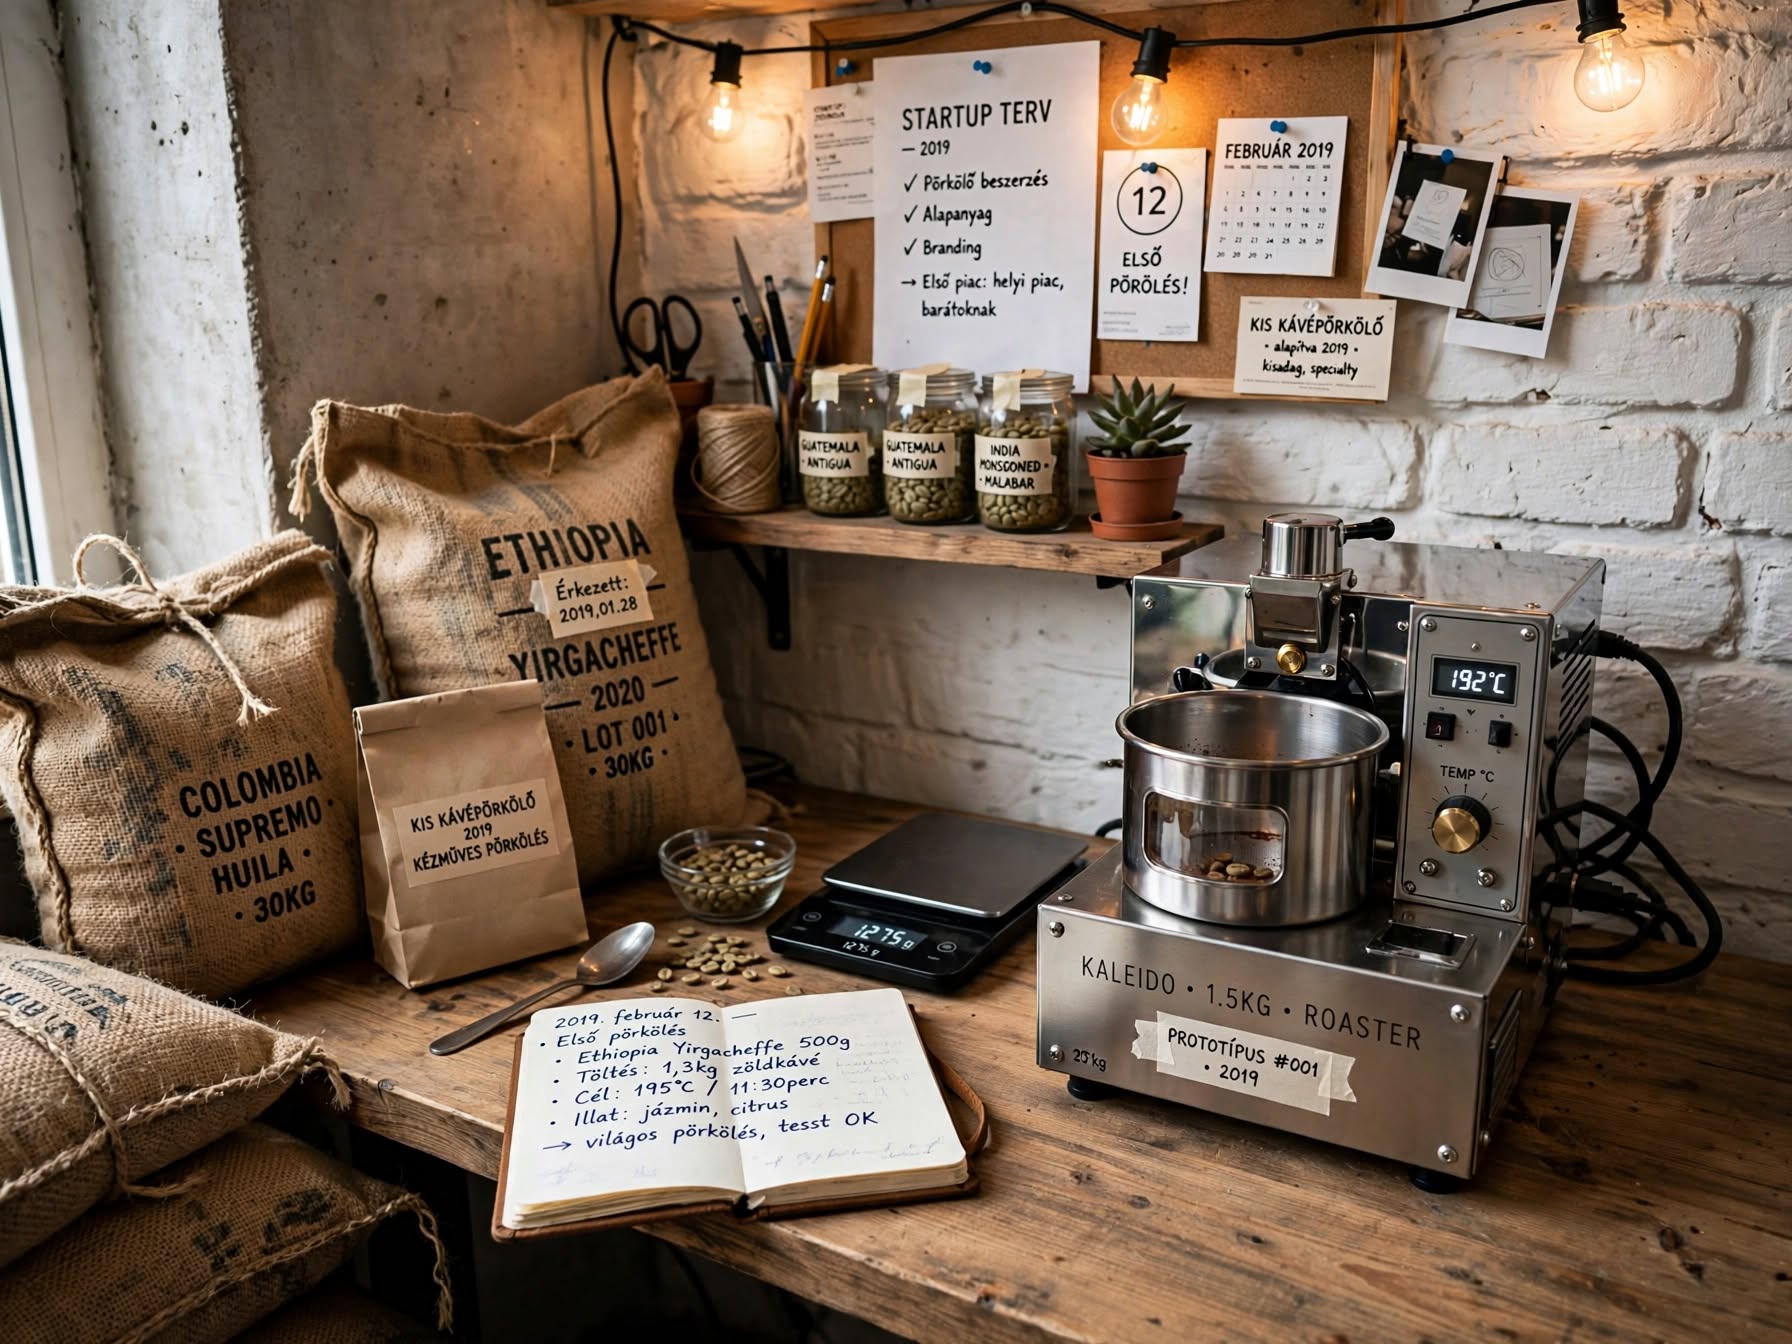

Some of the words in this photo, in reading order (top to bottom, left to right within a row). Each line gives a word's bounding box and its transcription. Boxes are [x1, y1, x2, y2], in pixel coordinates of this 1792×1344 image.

[902, 103, 993, 131] STARTUP
[1000, 98, 1052, 126] TERV
[920, 139, 950, 156] 2019
[1225, 138, 1291, 159] FEBRUÁR
[1297, 142, 1334, 159] 2019
[981, 169, 1048, 189] beszerzés
[1133, 186, 1167, 216] 12
[923, 205, 992, 227] Alapanyag
[923, 237, 982, 261] Branding
[1122, 245, 1162, 268] ELSŐ
[955, 274, 987, 295] piac:
[993, 271, 1025, 295] helyi
[1031, 272, 1064, 294] piac,
[922, 299, 997, 317] barátoknak
[1250, 317, 1272, 332] KIS
[1321, 342, 1349, 355] 2019
[1263, 358, 1306, 379] kisadag,
[1310, 362, 1359, 381] specialty
[802, 439, 861, 454] GUATEMALA
[886, 439, 946, 454] GUATEMALA
[990, 444, 1021, 457] INDIA
[807, 457, 852, 470] ANTIGUA
[891, 457, 938, 471] ANTIGUA
[984, 475, 1035, 490] MALABAR
[481, 518, 652, 581] ETHIOPIA
[556, 576, 629, 601] Érkezett:
[508, 622, 682, 683] YIRGACHEFFE
[590, 676, 645, 712] 2020
[1451, 669, 1506, 695] 192°C
[582, 719, 624, 753] LOT
[632, 709, 667, 741] 001
[604, 746, 655, 779] 30KG
[1440, 764, 1476, 781] TEMP
[1480, 769, 1495, 783] °C
[179, 752, 323, 818] COLOMBIA
[196, 795, 322, 858] SUPREMO
[410, 815, 434, 832] KIS
[463, 822, 492, 840] 2019
[212, 847, 294, 895] HUILA
[254, 880, 316, 923] 30KG
[1082, 955, 1176, 996] KALEIDO
[1207, 983, 1271, 1017] 1.5KG
[1305, 1003, 1421, 1051] ROASTER
[554, 1013, 605, 1029] 2019.
[614, 1006, 683, 1025] február
[693, 1009, 720, 1022] 12.
[556, 1028, 600, 1048] Első
[609, 1024, 687, 1047] pörkölés
[578, 1045, 659, 1064] Ethiopia
[673, 1039, 784, 1061] Yirgacheffe
[799, 1035, 850, 1050] 500g
[1168, 1027, 1265, 1065] PROTOTÍPUS
[1273, 1054, 1319, 1078] #001
[576, 1064, 649, 1084] Töltés:
[662, 1060, 717, 1079] 1,3kg
[732, 1053, 821, 1075] zöldkávé
[1219, 1064, 1259, 1088] 2019
[575, 1087, 620, 1105] Cél:
[634, 1079, 695, 1097] 195°C
[730, 1075, 830, 1095] 11:30perc
[574, 1107, 628, 1127] Illat:
[638, 1102, 718, 1125] jázmin,
[731, 1099, 788, 1116] citrus
[586, 1130, 658, 1150] világos
[673, 1123, 766, 1144] pörkölés,
[778, 1114, 831, 1133] tesst
[845, 1111, 878, 1127] OK
